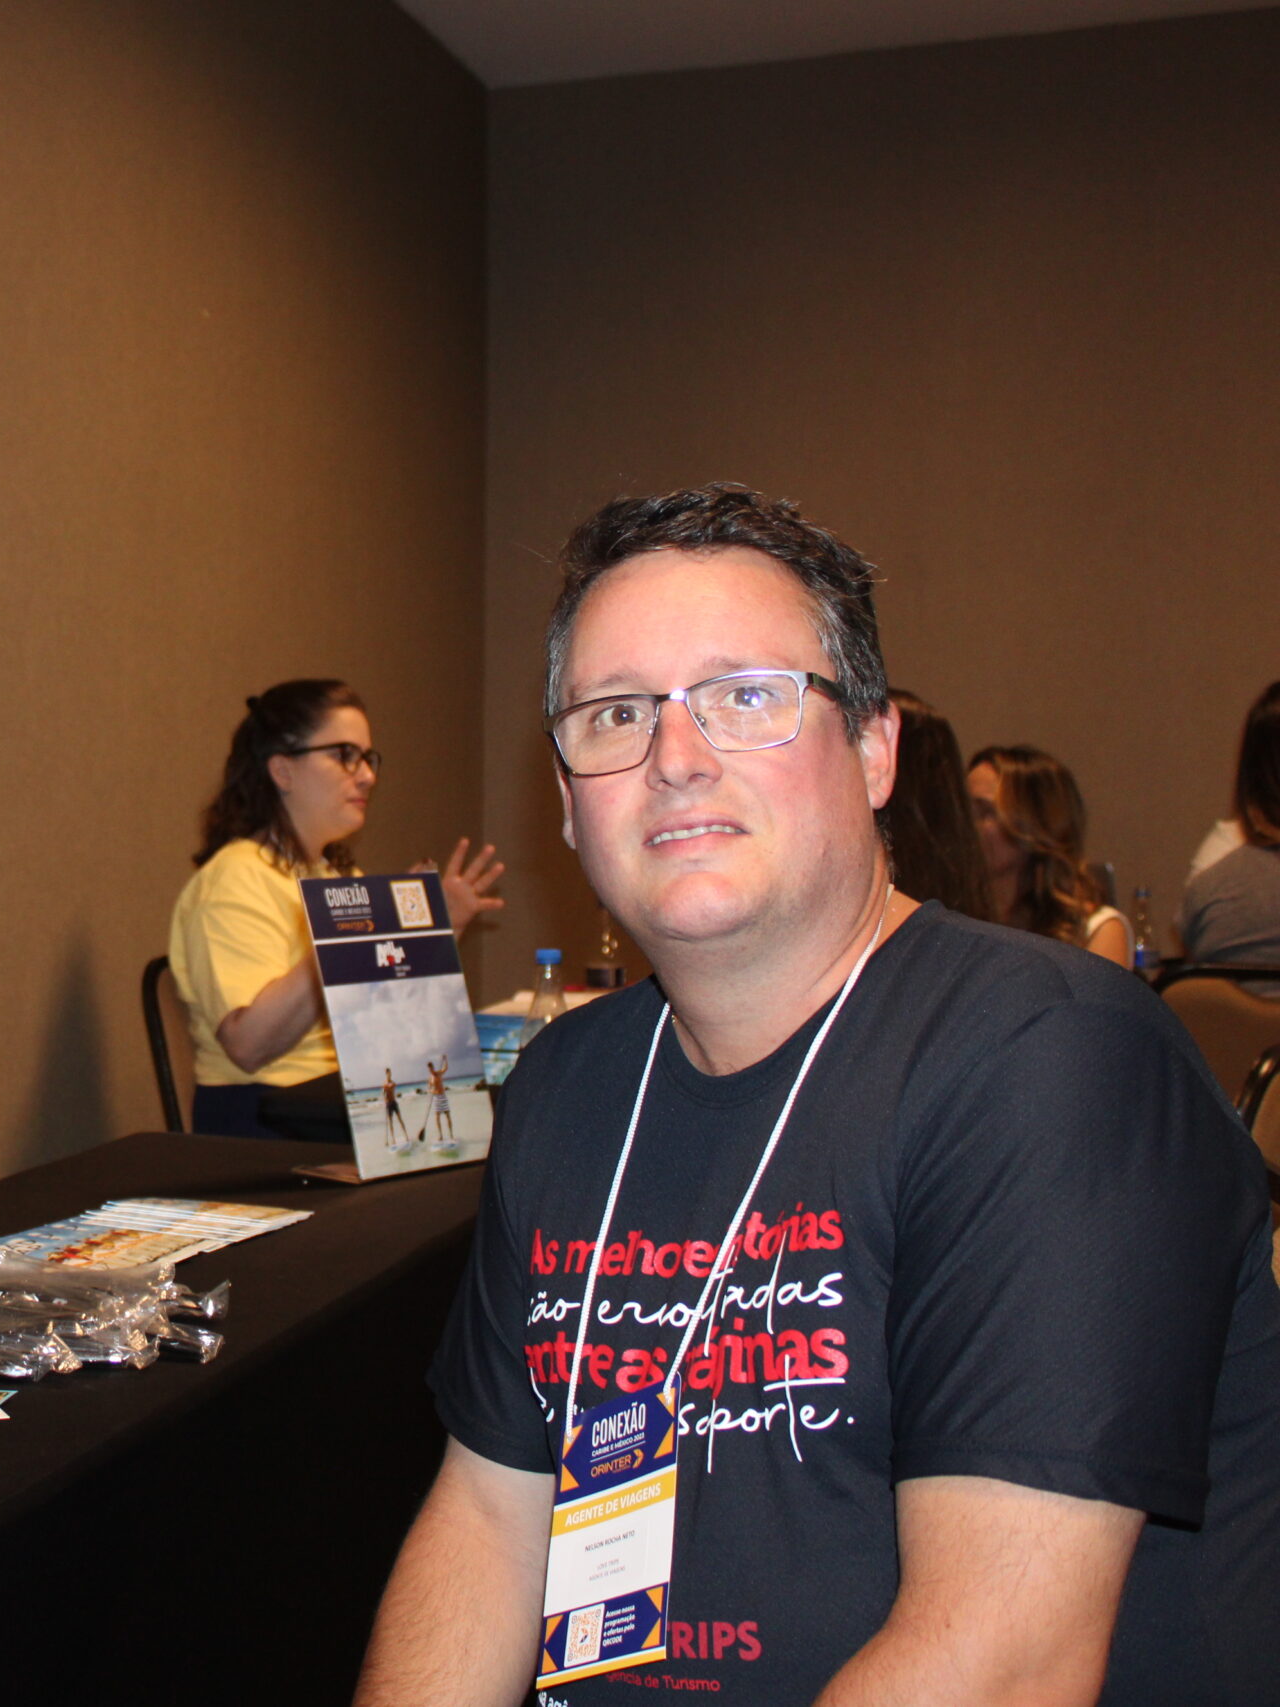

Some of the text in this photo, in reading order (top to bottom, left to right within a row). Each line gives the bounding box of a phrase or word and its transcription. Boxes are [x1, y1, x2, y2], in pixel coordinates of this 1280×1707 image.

[325, 883, 370, 908] CONEXÃO
[530, 1228, 559, 1275] As
[592, 1401, 646, 1448] CONEXÃO
[590, 1454, 632, 1478] ORINTER
[565, 1482, 662, 1527] AGENTE DE VIAGENS
[645, 1674, 659, 1689] de
